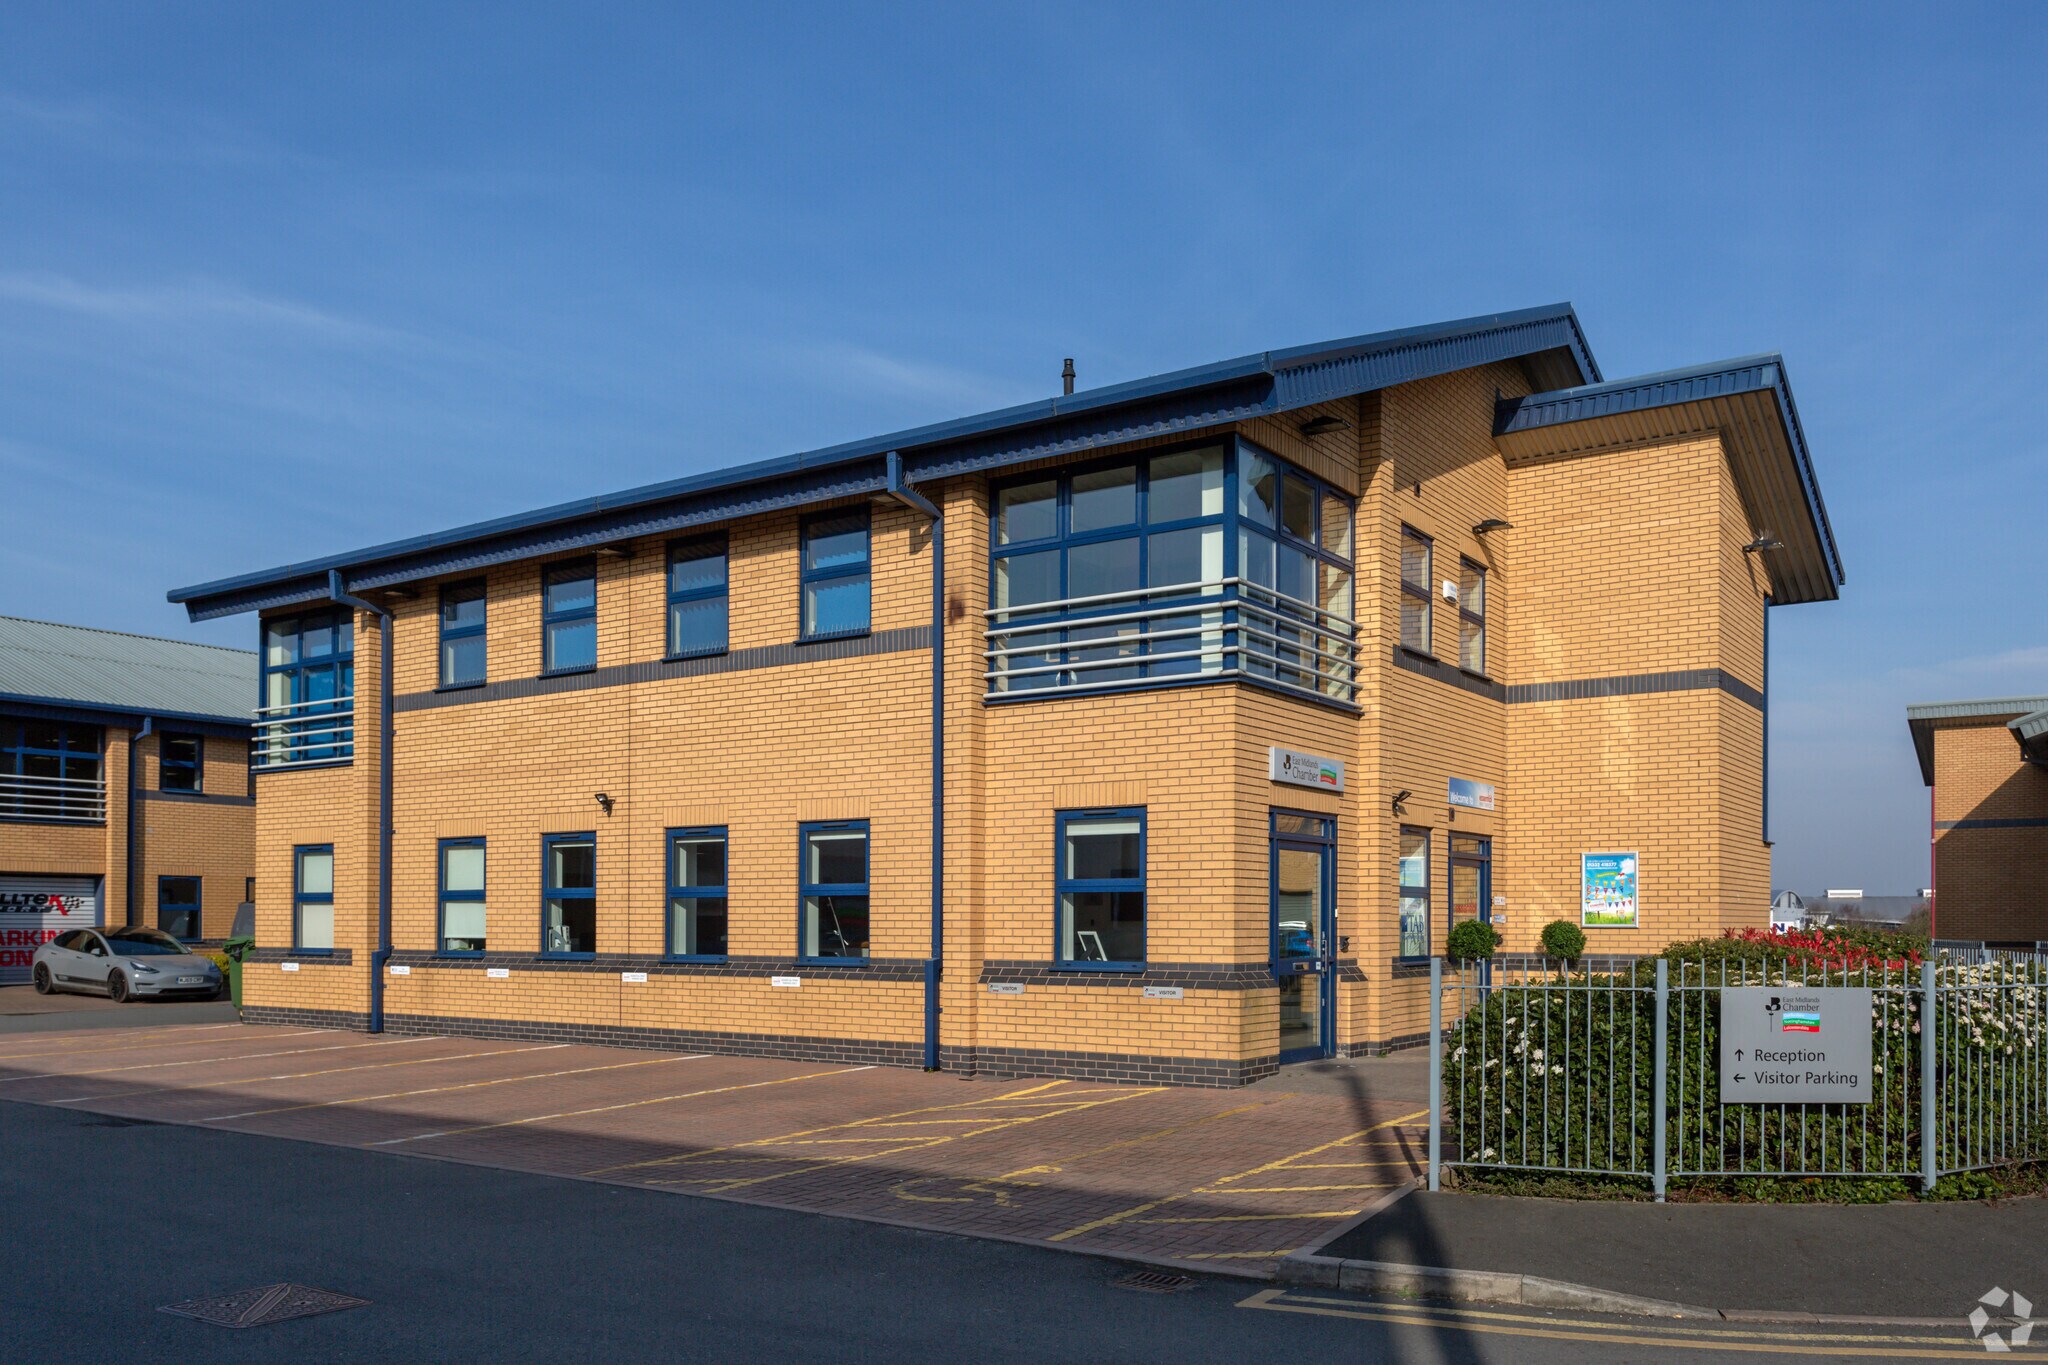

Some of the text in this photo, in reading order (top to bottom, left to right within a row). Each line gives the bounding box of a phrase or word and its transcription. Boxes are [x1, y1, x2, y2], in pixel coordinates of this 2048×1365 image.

[1293, 766, 1319, 782] Chamber
[1450, 791, 1469, 804] Welcome
[1783, 1003, 1820, 1011] Chamber
[1755, 1049, 1825, 1064] Reception
[1754, 1071, 1858, 1087] Visitor Parking
